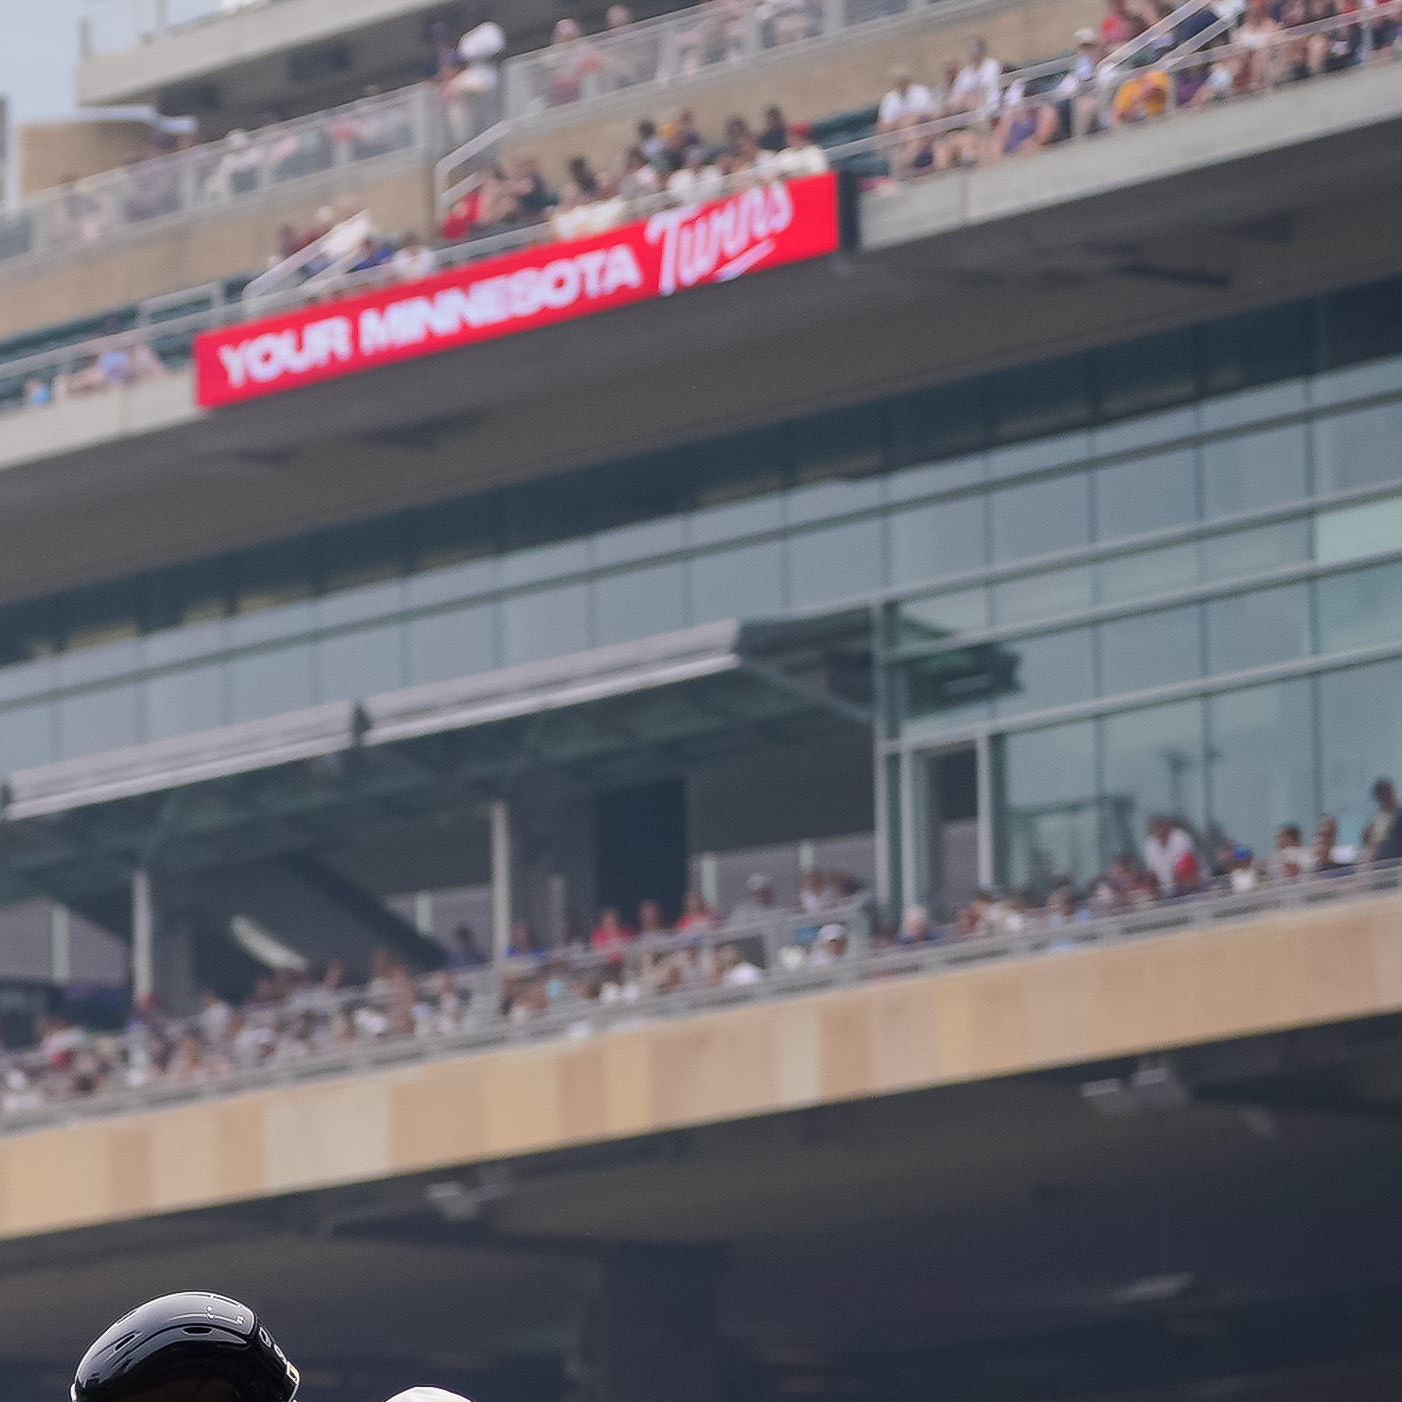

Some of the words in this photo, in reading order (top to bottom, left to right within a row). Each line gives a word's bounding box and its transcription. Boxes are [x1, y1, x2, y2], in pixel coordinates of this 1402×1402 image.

[217, 315, 354, 388] YOUR
[359, 245, 645, 357] MINNESOTA
[646, 178, 794, 296] Twins
